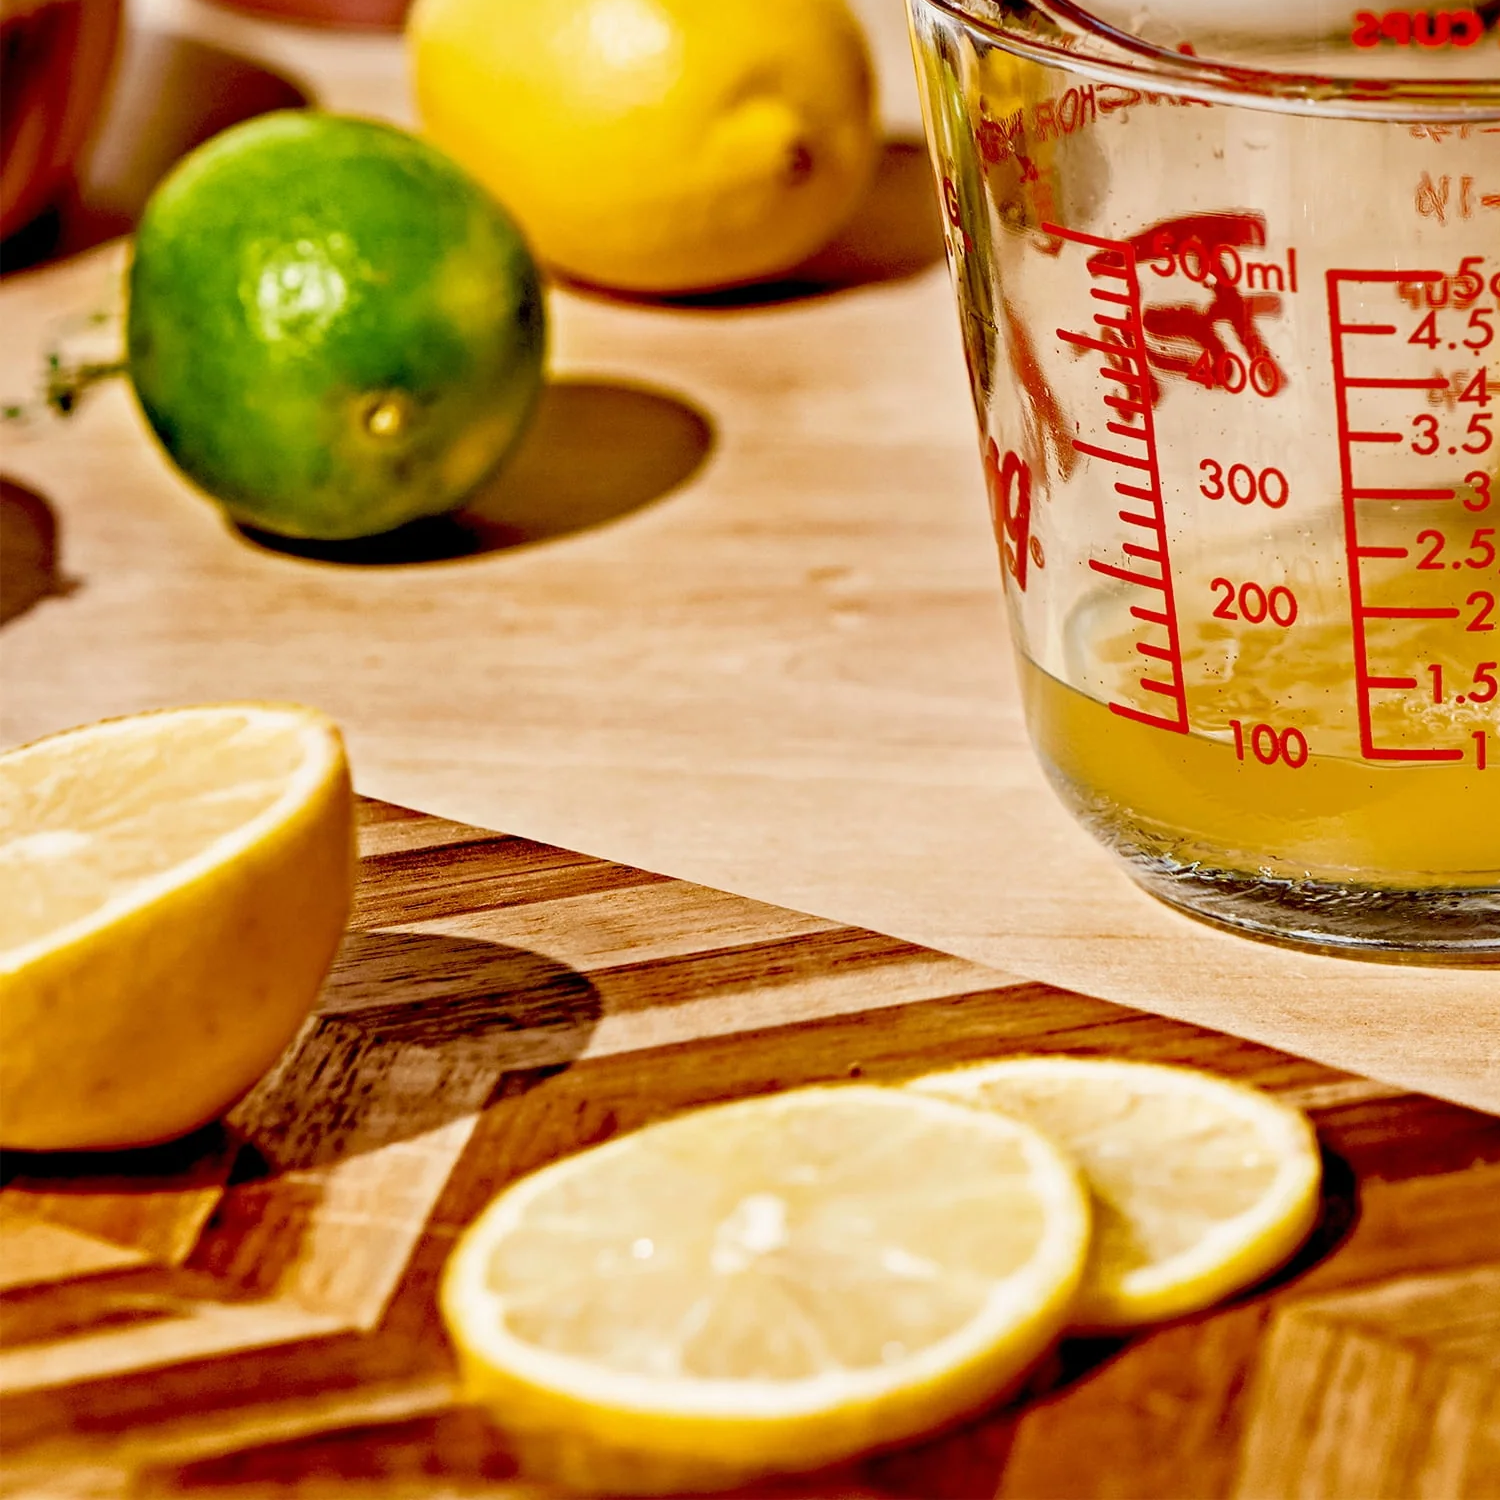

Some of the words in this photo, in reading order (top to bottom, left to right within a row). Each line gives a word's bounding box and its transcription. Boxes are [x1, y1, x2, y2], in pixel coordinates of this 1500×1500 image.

[1149, 233, 1299, 294] 500ml
[1407, 307, 1495, 350] 4.5
[1186, 347, 1281, 399] 400
[1458, 366, 1493, 408] 4
[1410, 412, 1493, 456] 3.5
[1199, 457, 1290, 509] 300
[1461, 470, 1492, 513] 3
[1415, 527, 1496, 570] 2.5
[1210, 577, 1299, 628] 200
[1464, 590, 1496, 633] 2
[1427, 661, 1499, 705] 1.5
[1228, 719, 1310, 770] 100
[1470, 730, 1487, 771] 1
